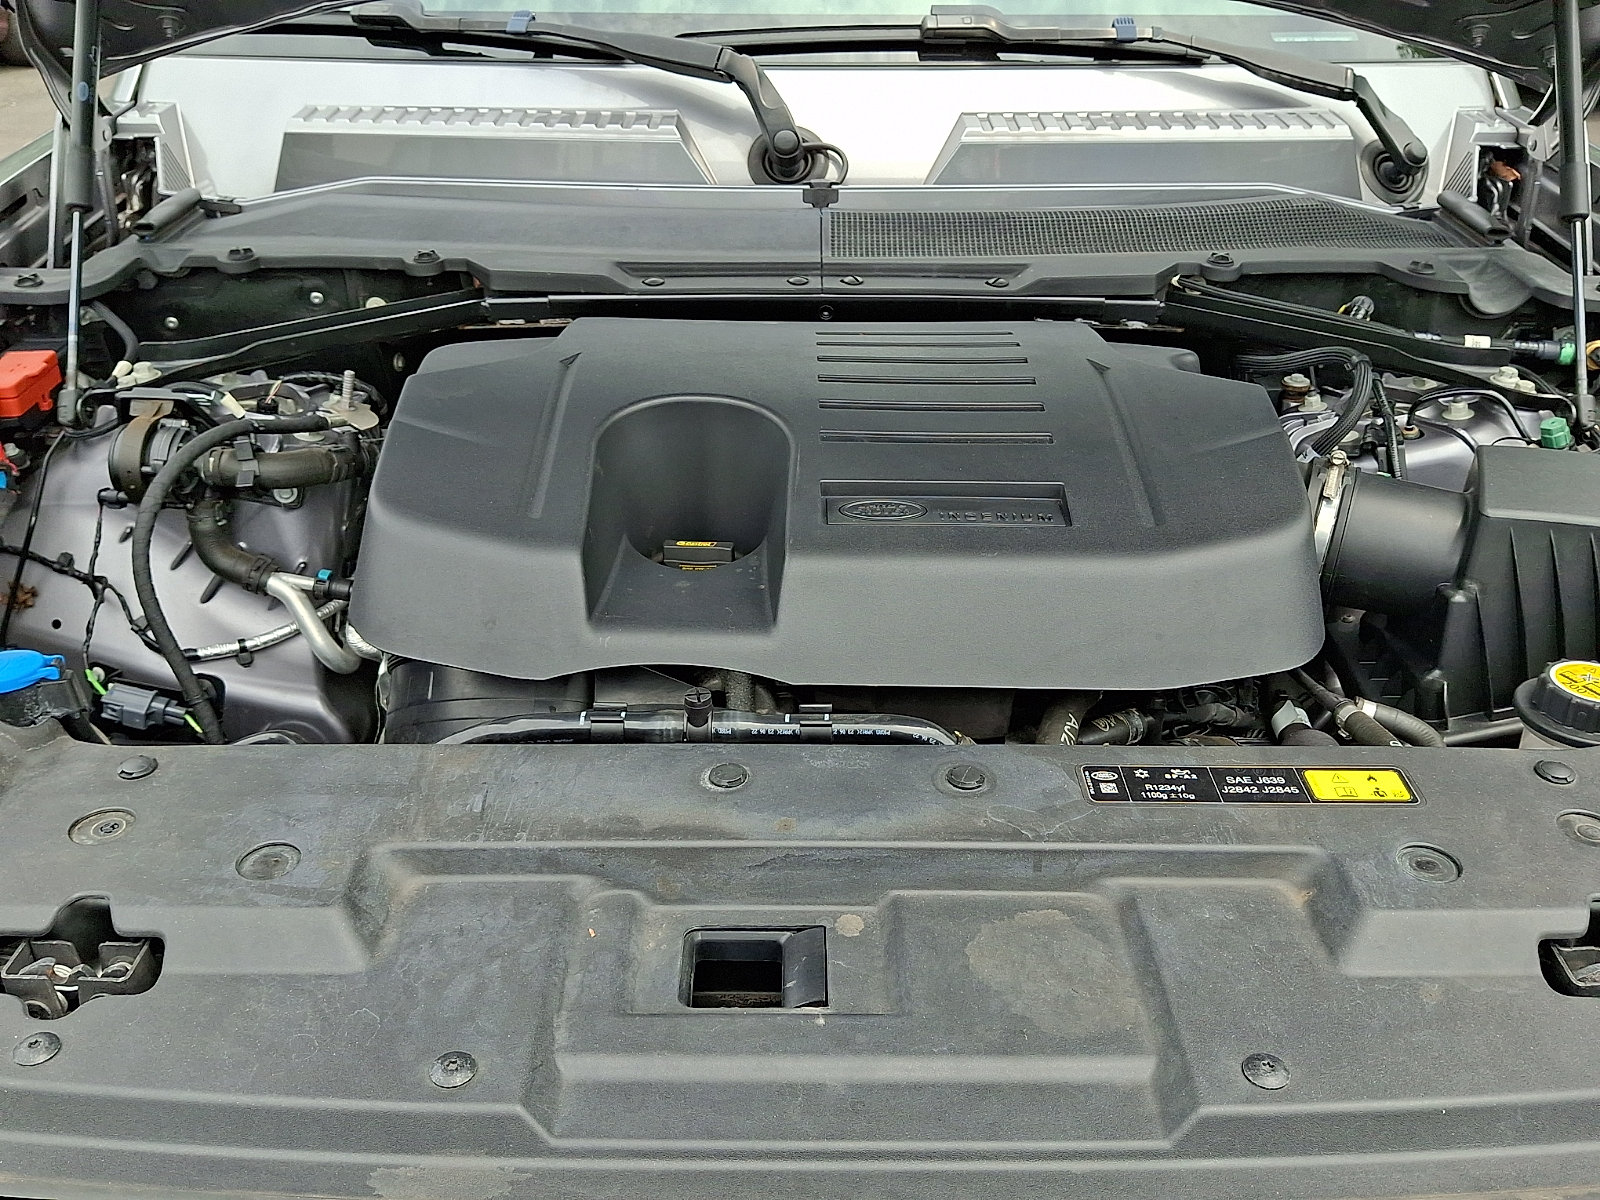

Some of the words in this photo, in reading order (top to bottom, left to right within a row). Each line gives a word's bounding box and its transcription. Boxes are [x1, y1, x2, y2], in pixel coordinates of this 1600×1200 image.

[938, 511, 1054, 523] INGENIUM
[1225, 776, 1253, 784] SAE
[1256, 776, 1286, 784] J639
[1144, 783, 1186, 792] R1234yf
[1221, 785, 1260, 794] J2842
[1262, 786, 1300, 794] J2845
[1140, 791, 1168, 800] 1100g
